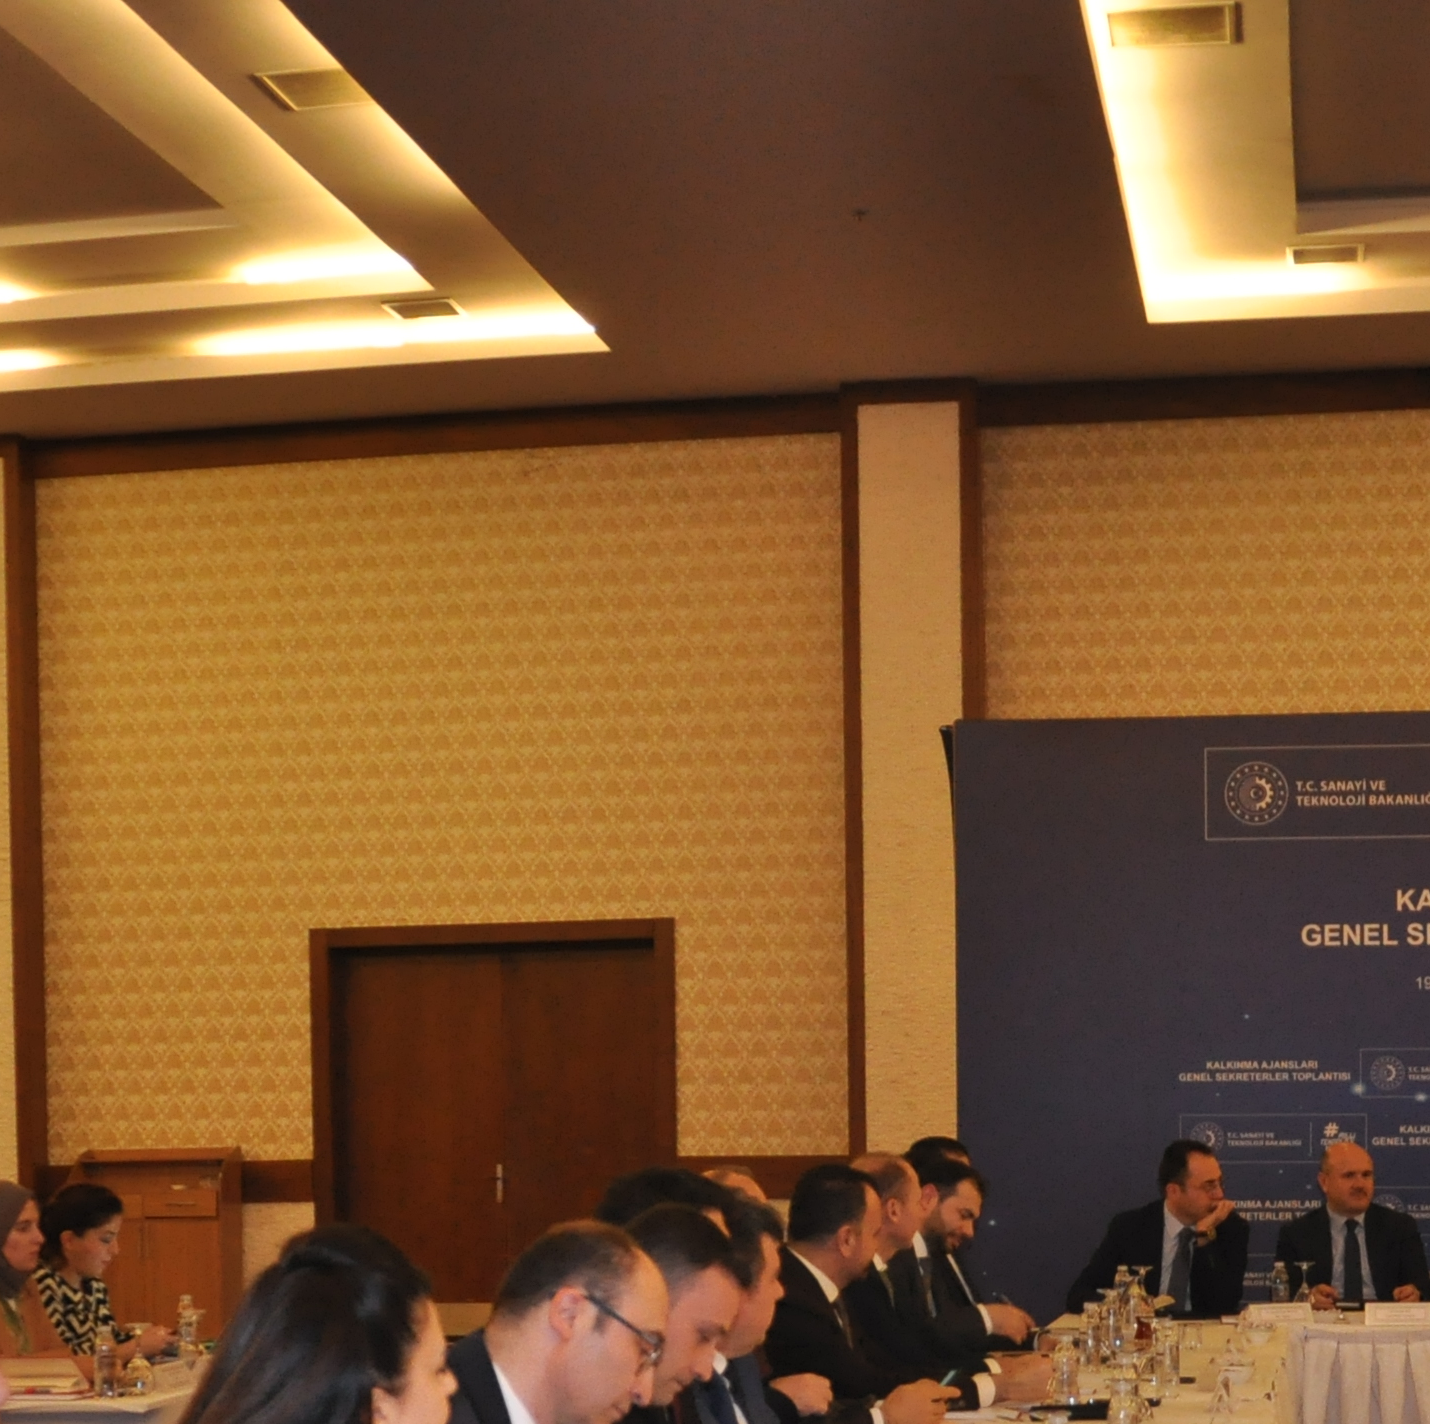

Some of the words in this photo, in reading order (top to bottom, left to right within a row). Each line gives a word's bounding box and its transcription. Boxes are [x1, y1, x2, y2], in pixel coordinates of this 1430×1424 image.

[1295, 780, 1318, 792] T.C.
[1320, 778, 1367, 792] SANAYİ
[1369, 780, 1387, 792] VE
[1295, 793, 1366, 806] TEKNOLOJİ
[1300, 922, 1399, 947] GENEL
[1205, 1060, 1259, 1070] KALKINMA
[1260, 1059, 1319, 1070] AJANSLARI
[1177, 1072, 1213, 1083] GENEL
[1214, 1071, 1290, 1082] SEKRETERLER
[1291, 1071, 1352, 1081] TOPLANTISI
[1371, 1136, 1407, 1146] GENEL
[1264, 1199, 1321, 1208] AJANSLARI
